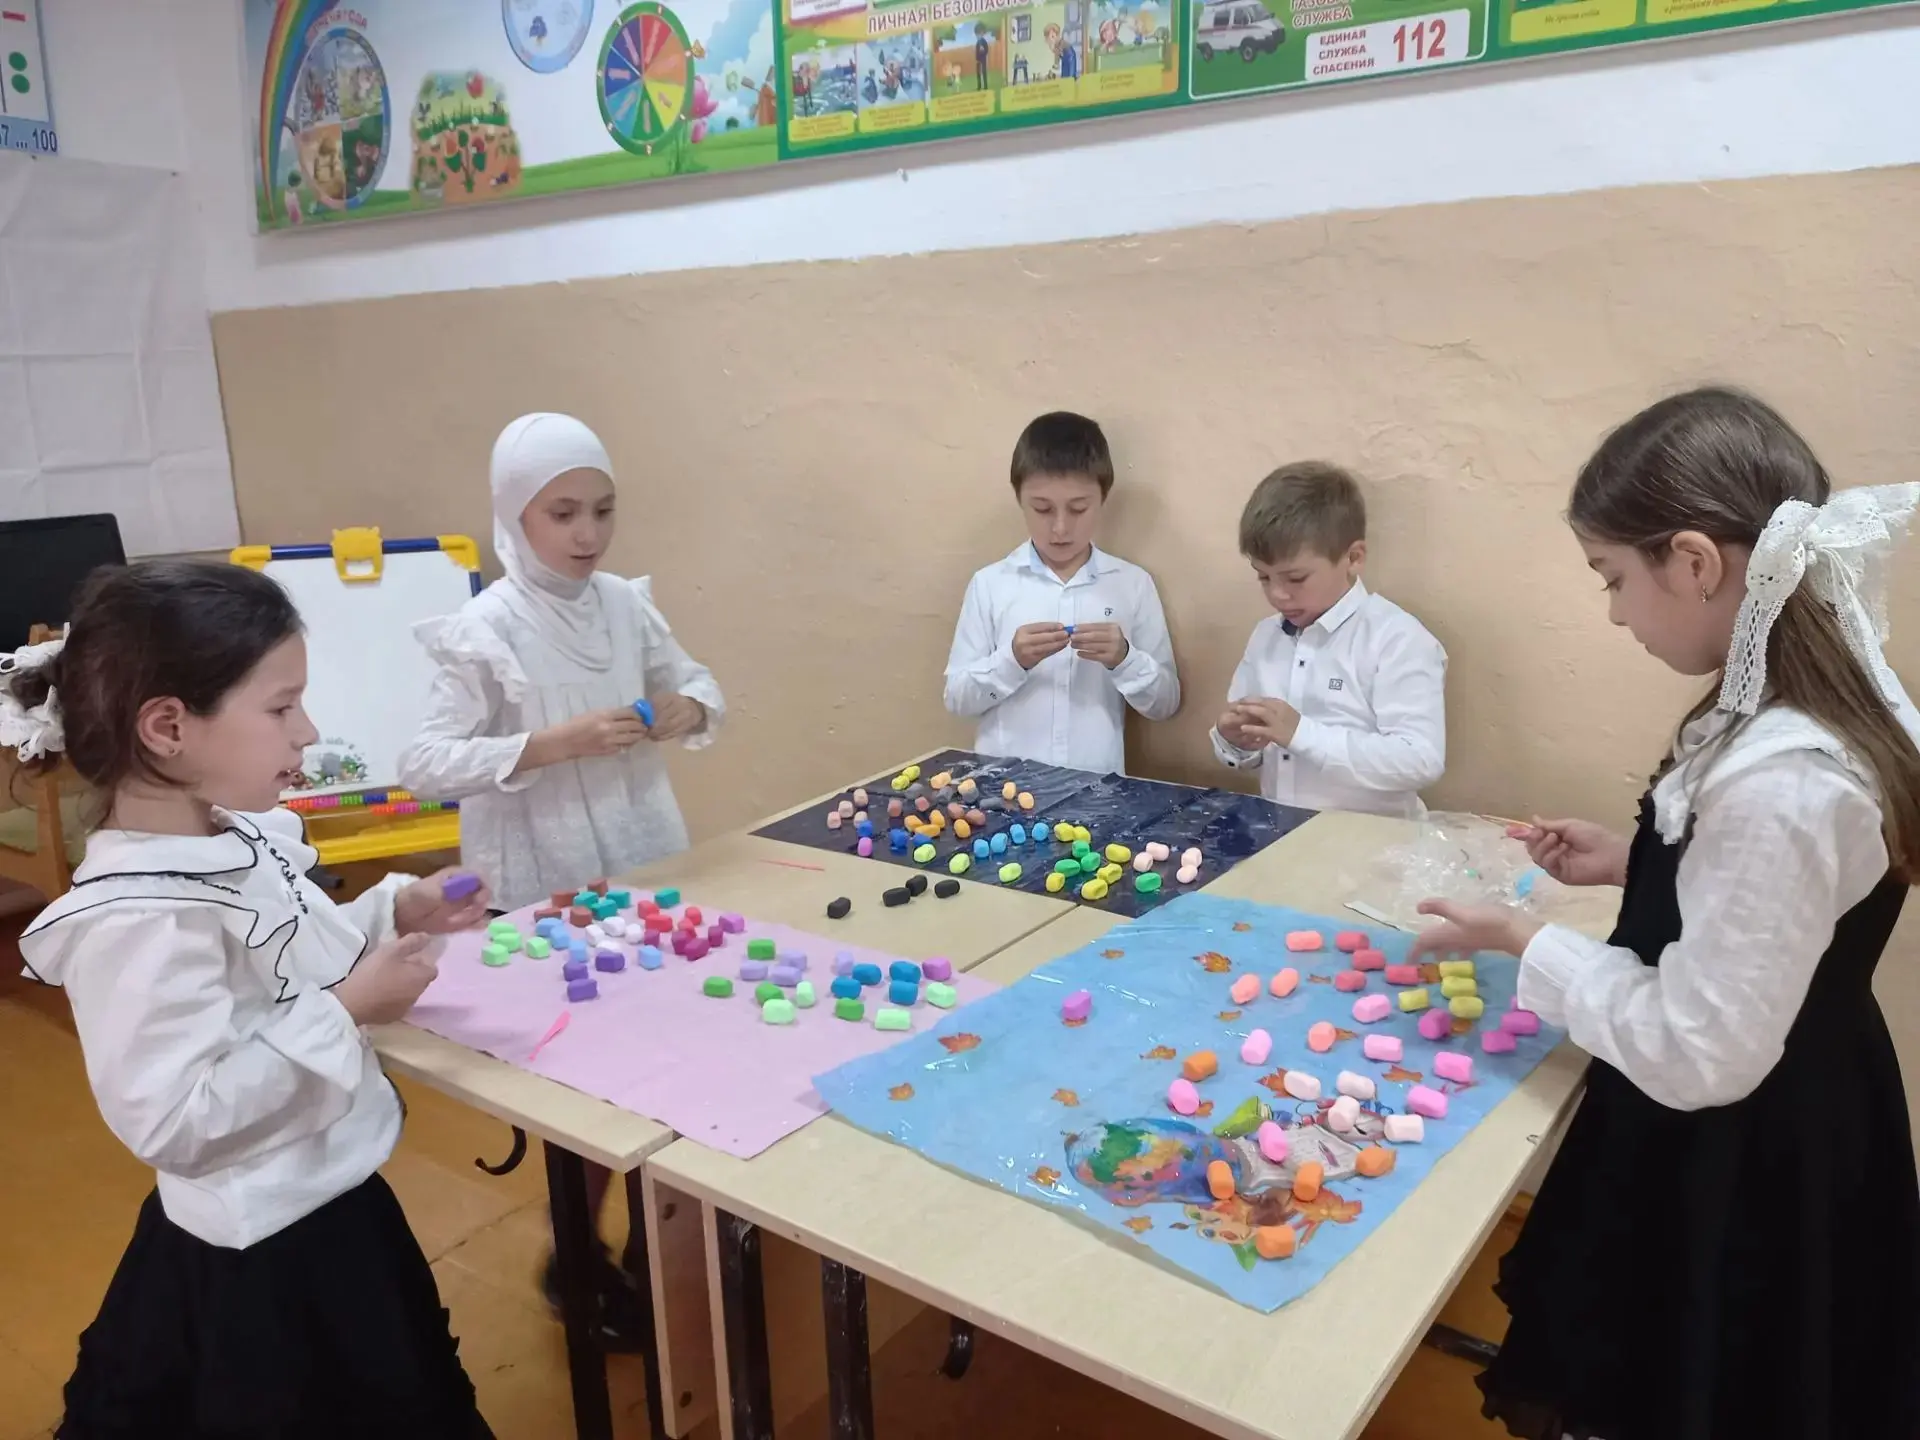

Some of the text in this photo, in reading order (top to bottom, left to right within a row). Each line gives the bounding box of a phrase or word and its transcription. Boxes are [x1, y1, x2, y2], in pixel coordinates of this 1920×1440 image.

[867, 0, 1029, 33] ЛИЧНАЯ БЕЗОПА
[1293, 5, 1353, 27] СЛУЖБА
[1319, 29, 1367, 46] ЕДИНАЯ
[1393, 19, 1446, 62] 112
[1318, 44, 1367, 60] СЛУЖБА
[1312, 57, 1375, 75] СПАСЕНИЯ
[32, 127, 58, 153] 100
